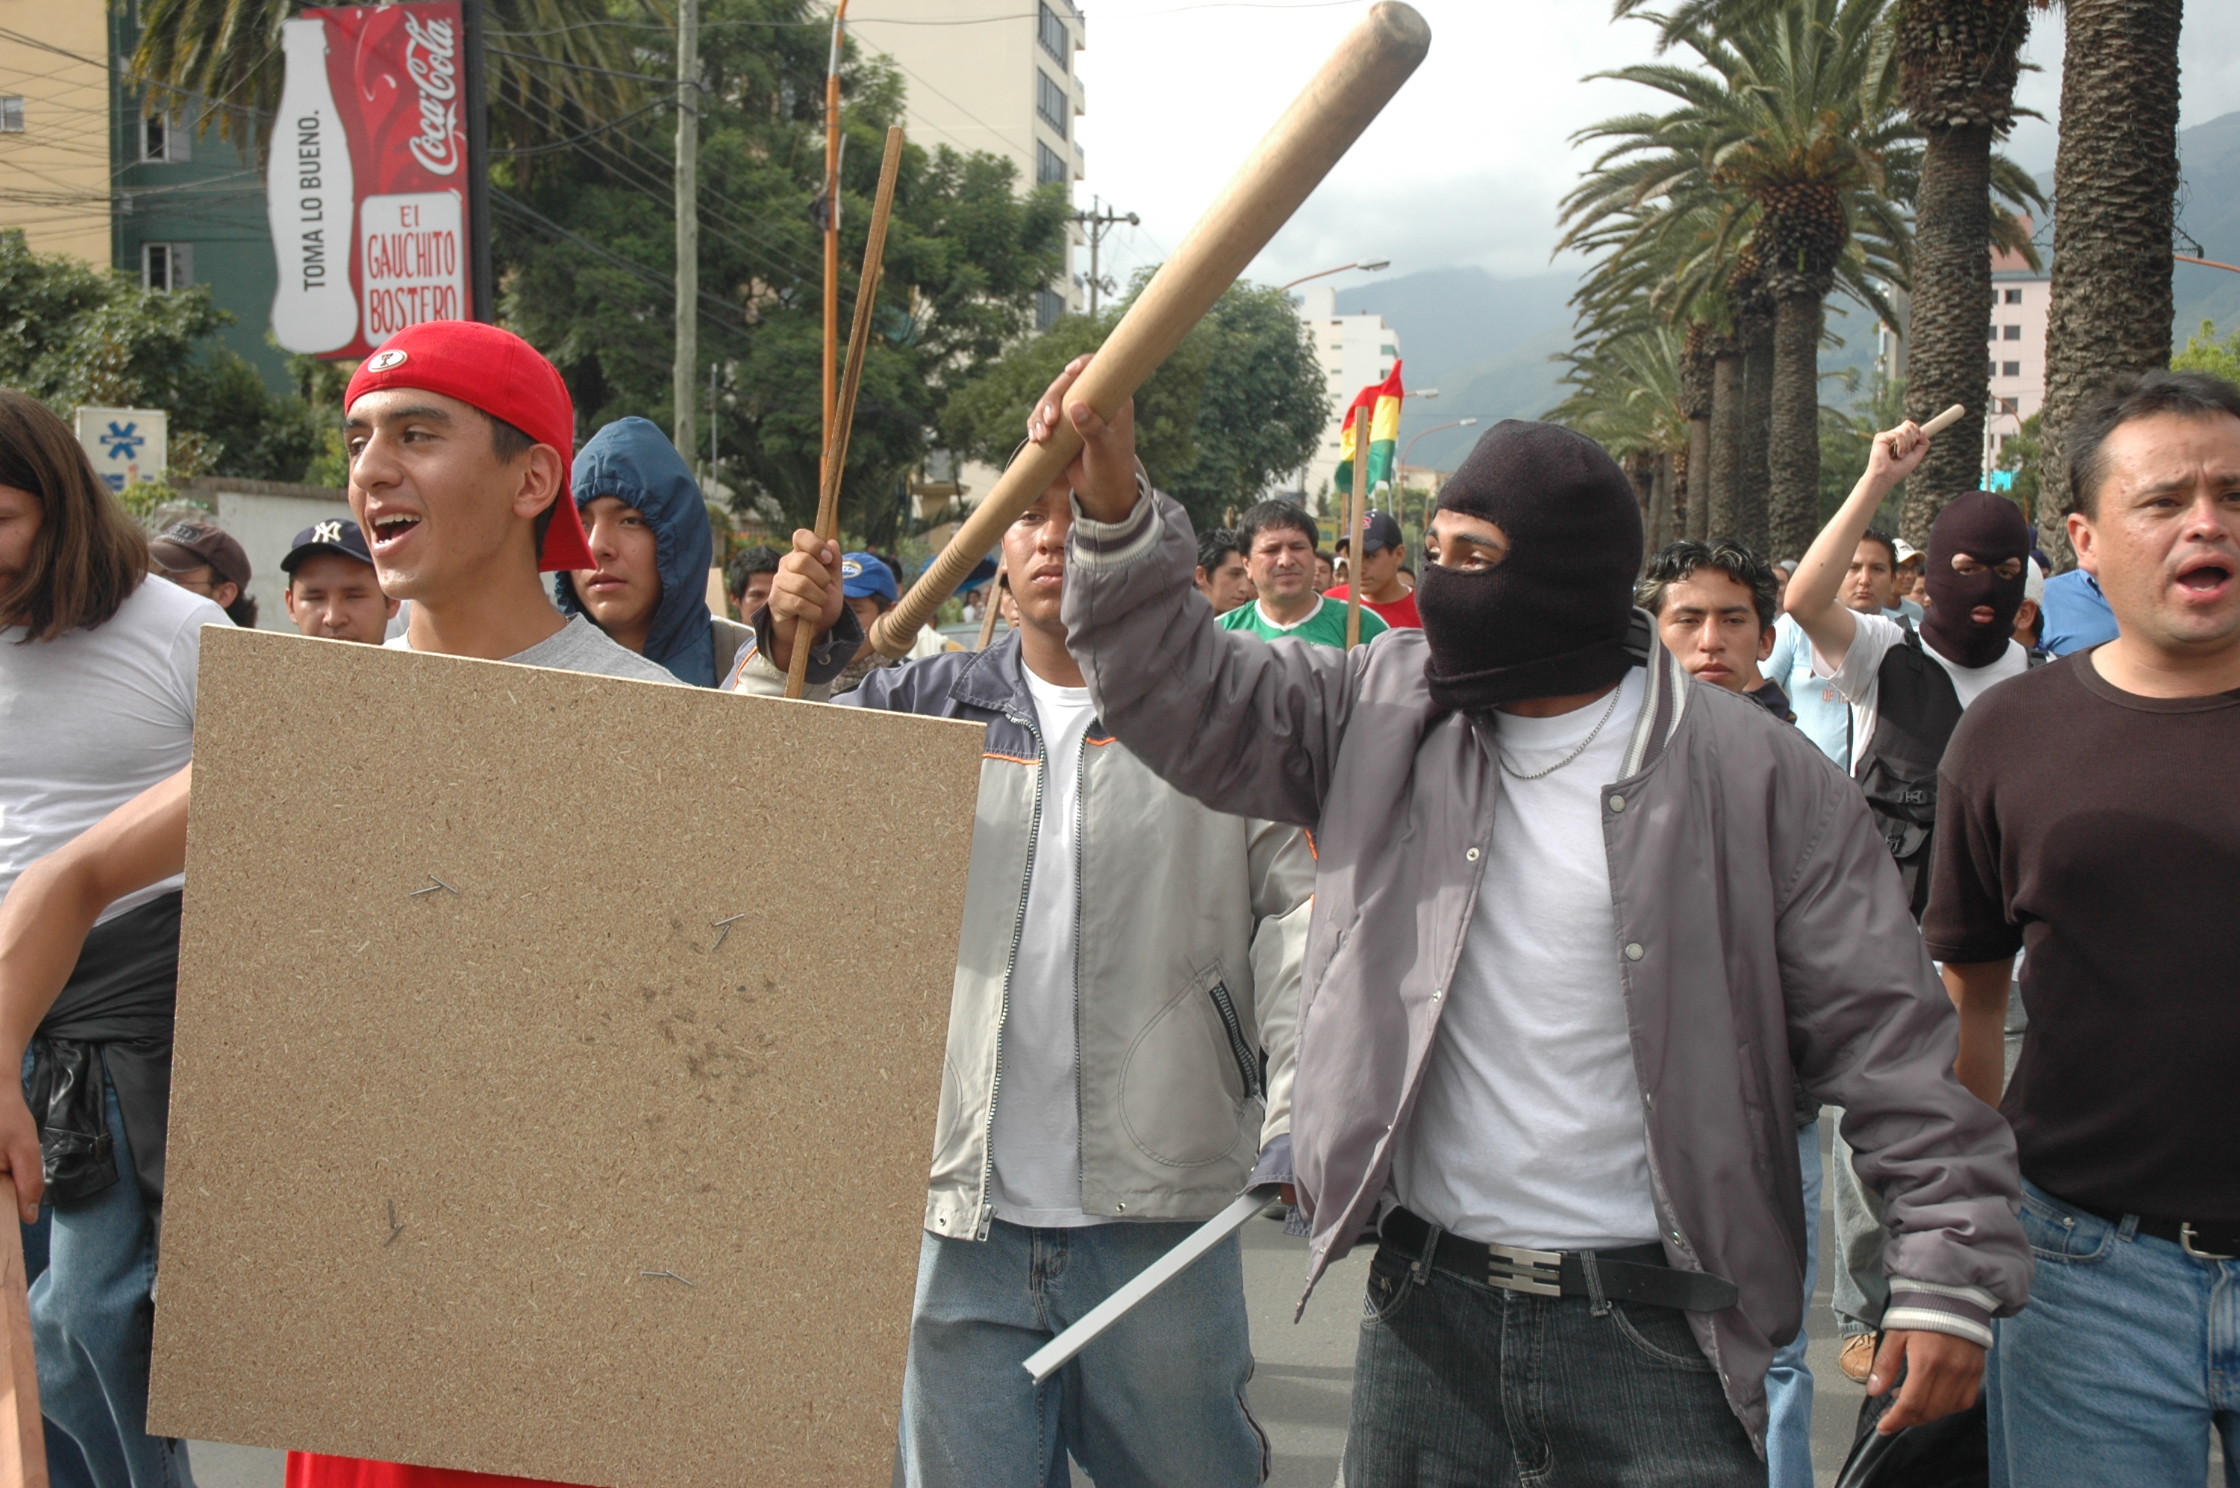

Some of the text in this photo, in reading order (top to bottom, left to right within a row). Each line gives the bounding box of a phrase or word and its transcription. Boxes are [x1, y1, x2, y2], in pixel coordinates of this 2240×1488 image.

[297, 110, 326, 292] TOMA LO BUENO.
[367, 230, 456, 279] GAUCHITO
[370, 284, 457, 334] BOSTERO
[311, 521, 342, 543] NY
